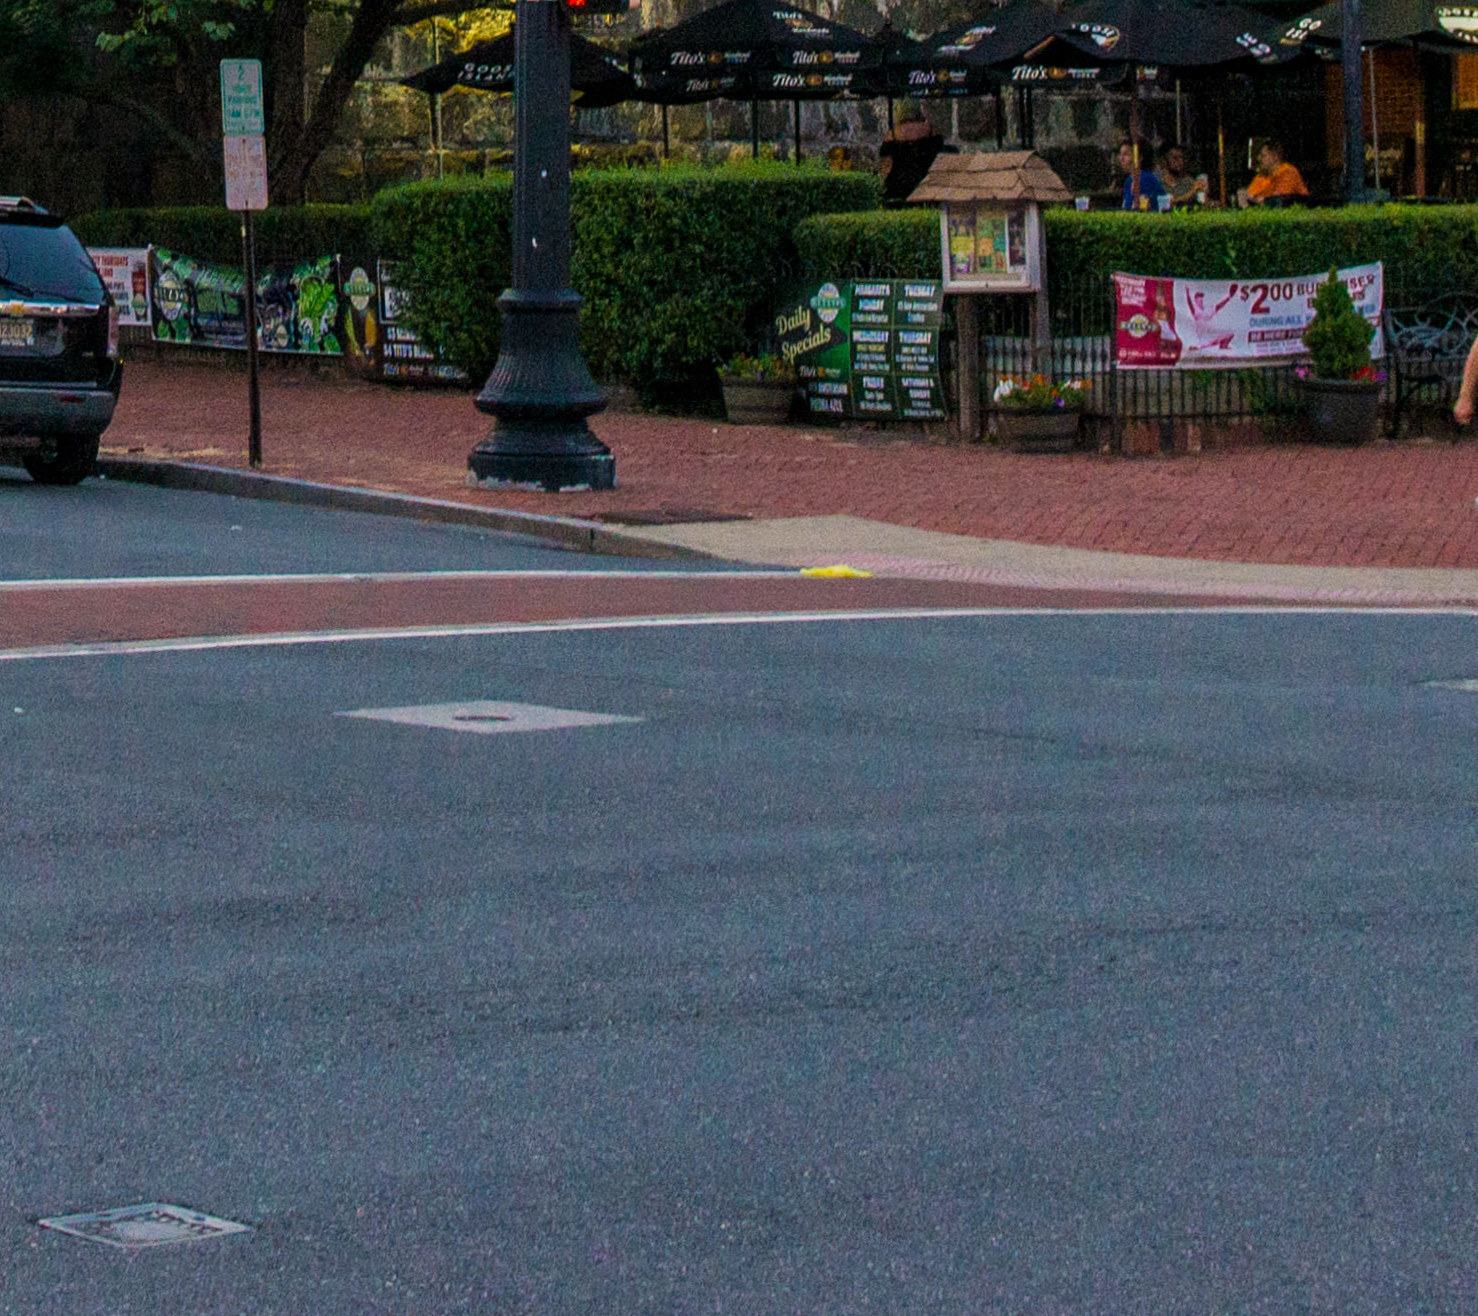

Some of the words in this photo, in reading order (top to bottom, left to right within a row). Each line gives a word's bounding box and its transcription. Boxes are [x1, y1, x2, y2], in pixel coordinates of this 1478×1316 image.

[670, 51, 706, 66] Tito's
[792, 50, 819, 65] Tito's
[772, 73, 805, 87] Tito's
[1011, 66, 1049, 81] Tito's
[776, 305, 811, 335] Daily
[781, 323, 832, 365] Specials
